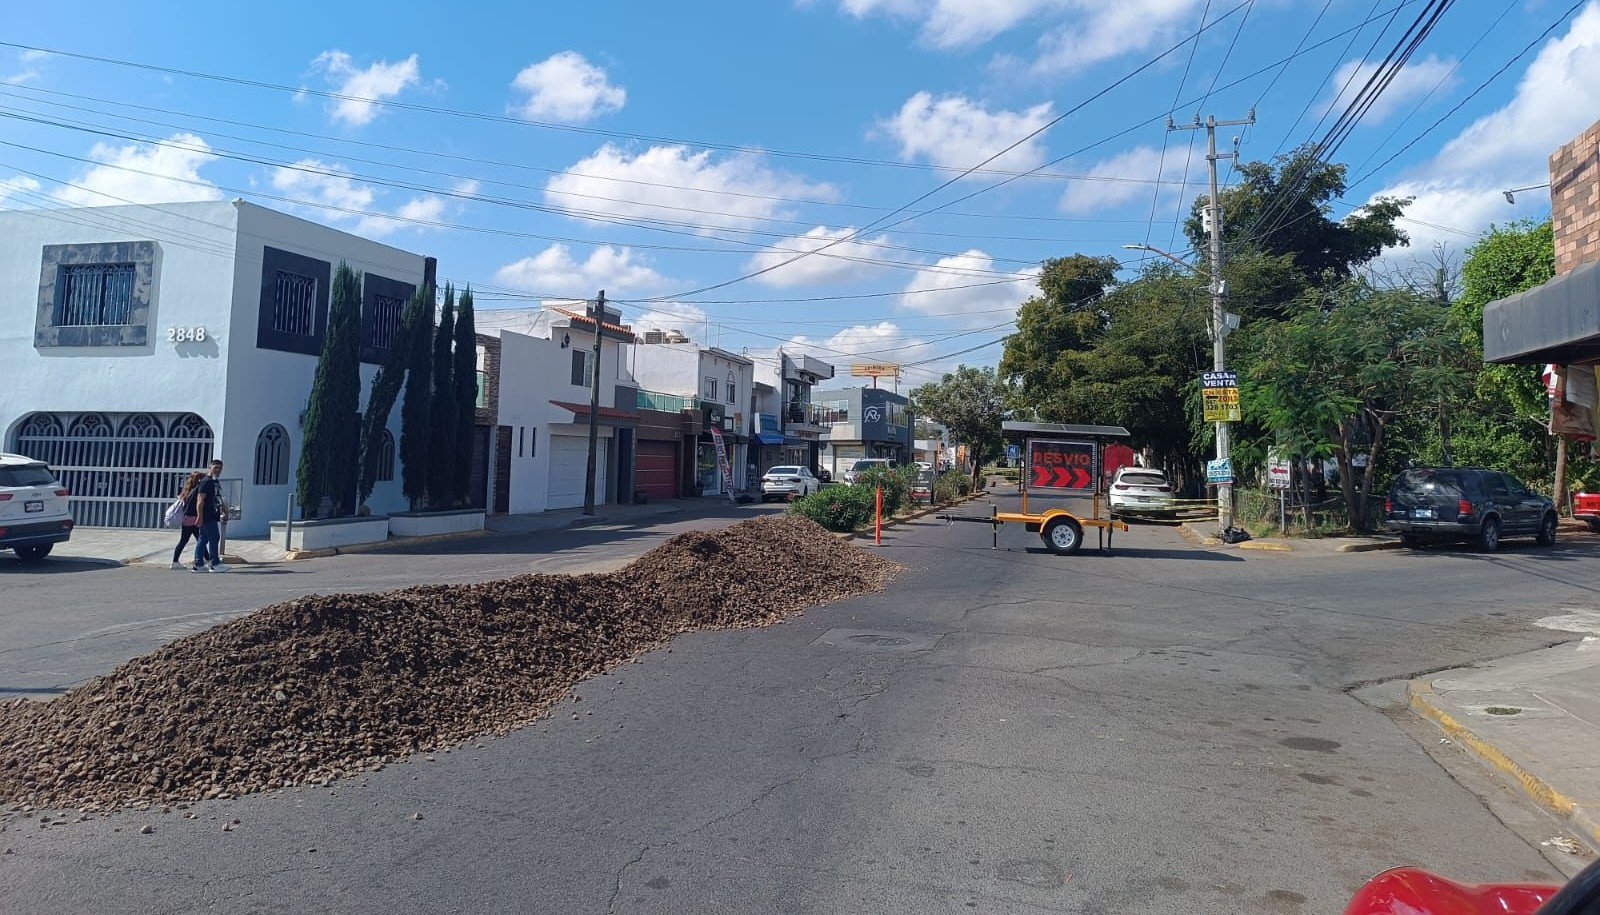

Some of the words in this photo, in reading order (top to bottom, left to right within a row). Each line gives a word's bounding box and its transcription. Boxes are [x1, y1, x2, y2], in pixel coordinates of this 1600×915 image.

[167, 328, 205, 342] 2848
[1203, 372, 1229, 380] CASA
[1203, 379, 1236, 387] VENTA
[1217, 395, 1238, 403] ZONA
[1033, 452, 1090, 465] DESVIO
